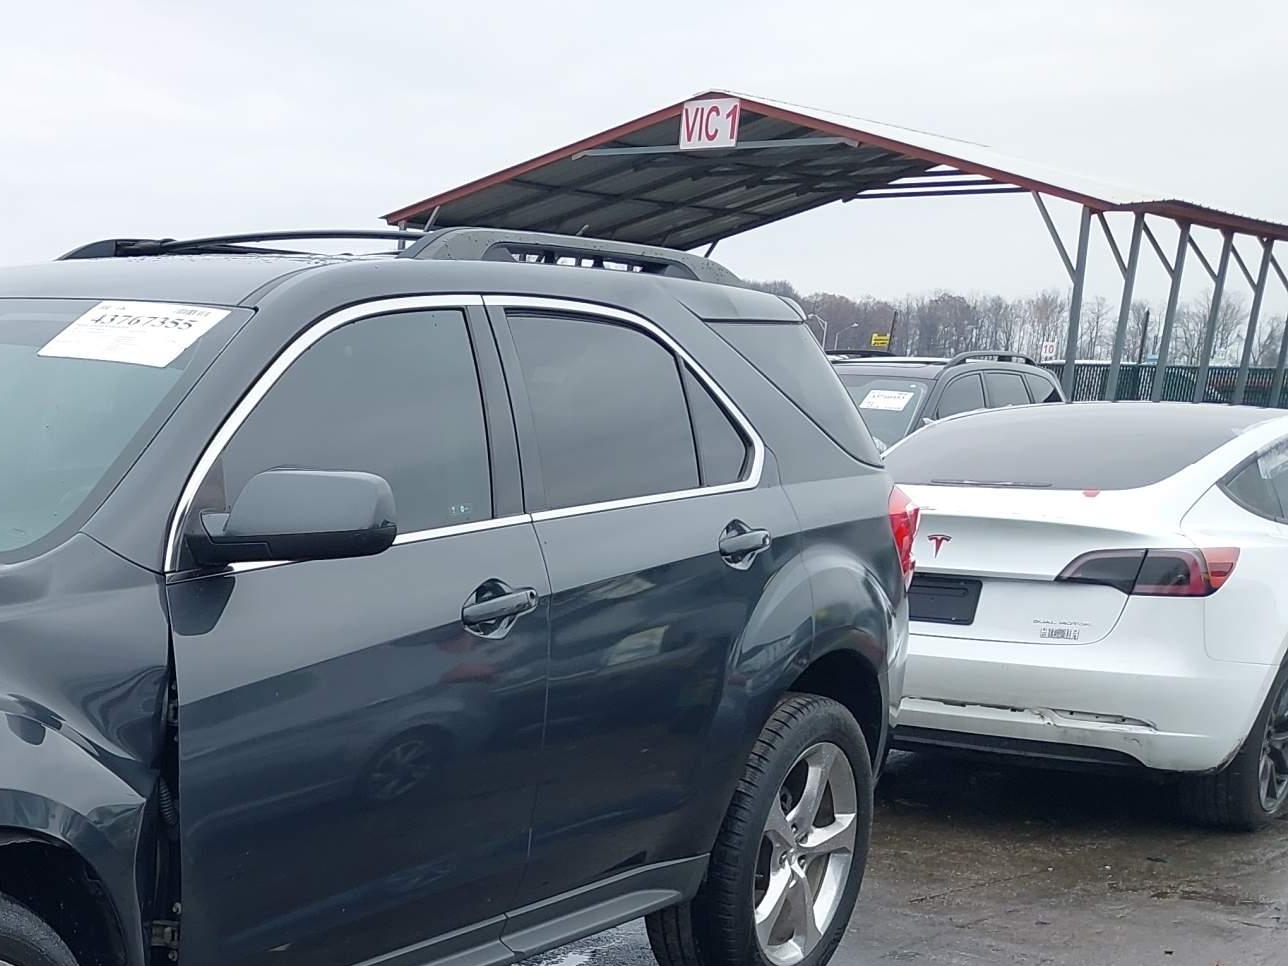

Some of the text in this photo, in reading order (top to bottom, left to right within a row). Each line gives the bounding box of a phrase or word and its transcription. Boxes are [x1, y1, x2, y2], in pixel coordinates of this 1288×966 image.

[684, 103, 738, 142] VIC 1
[90, 314, 200, 331] 43767355
